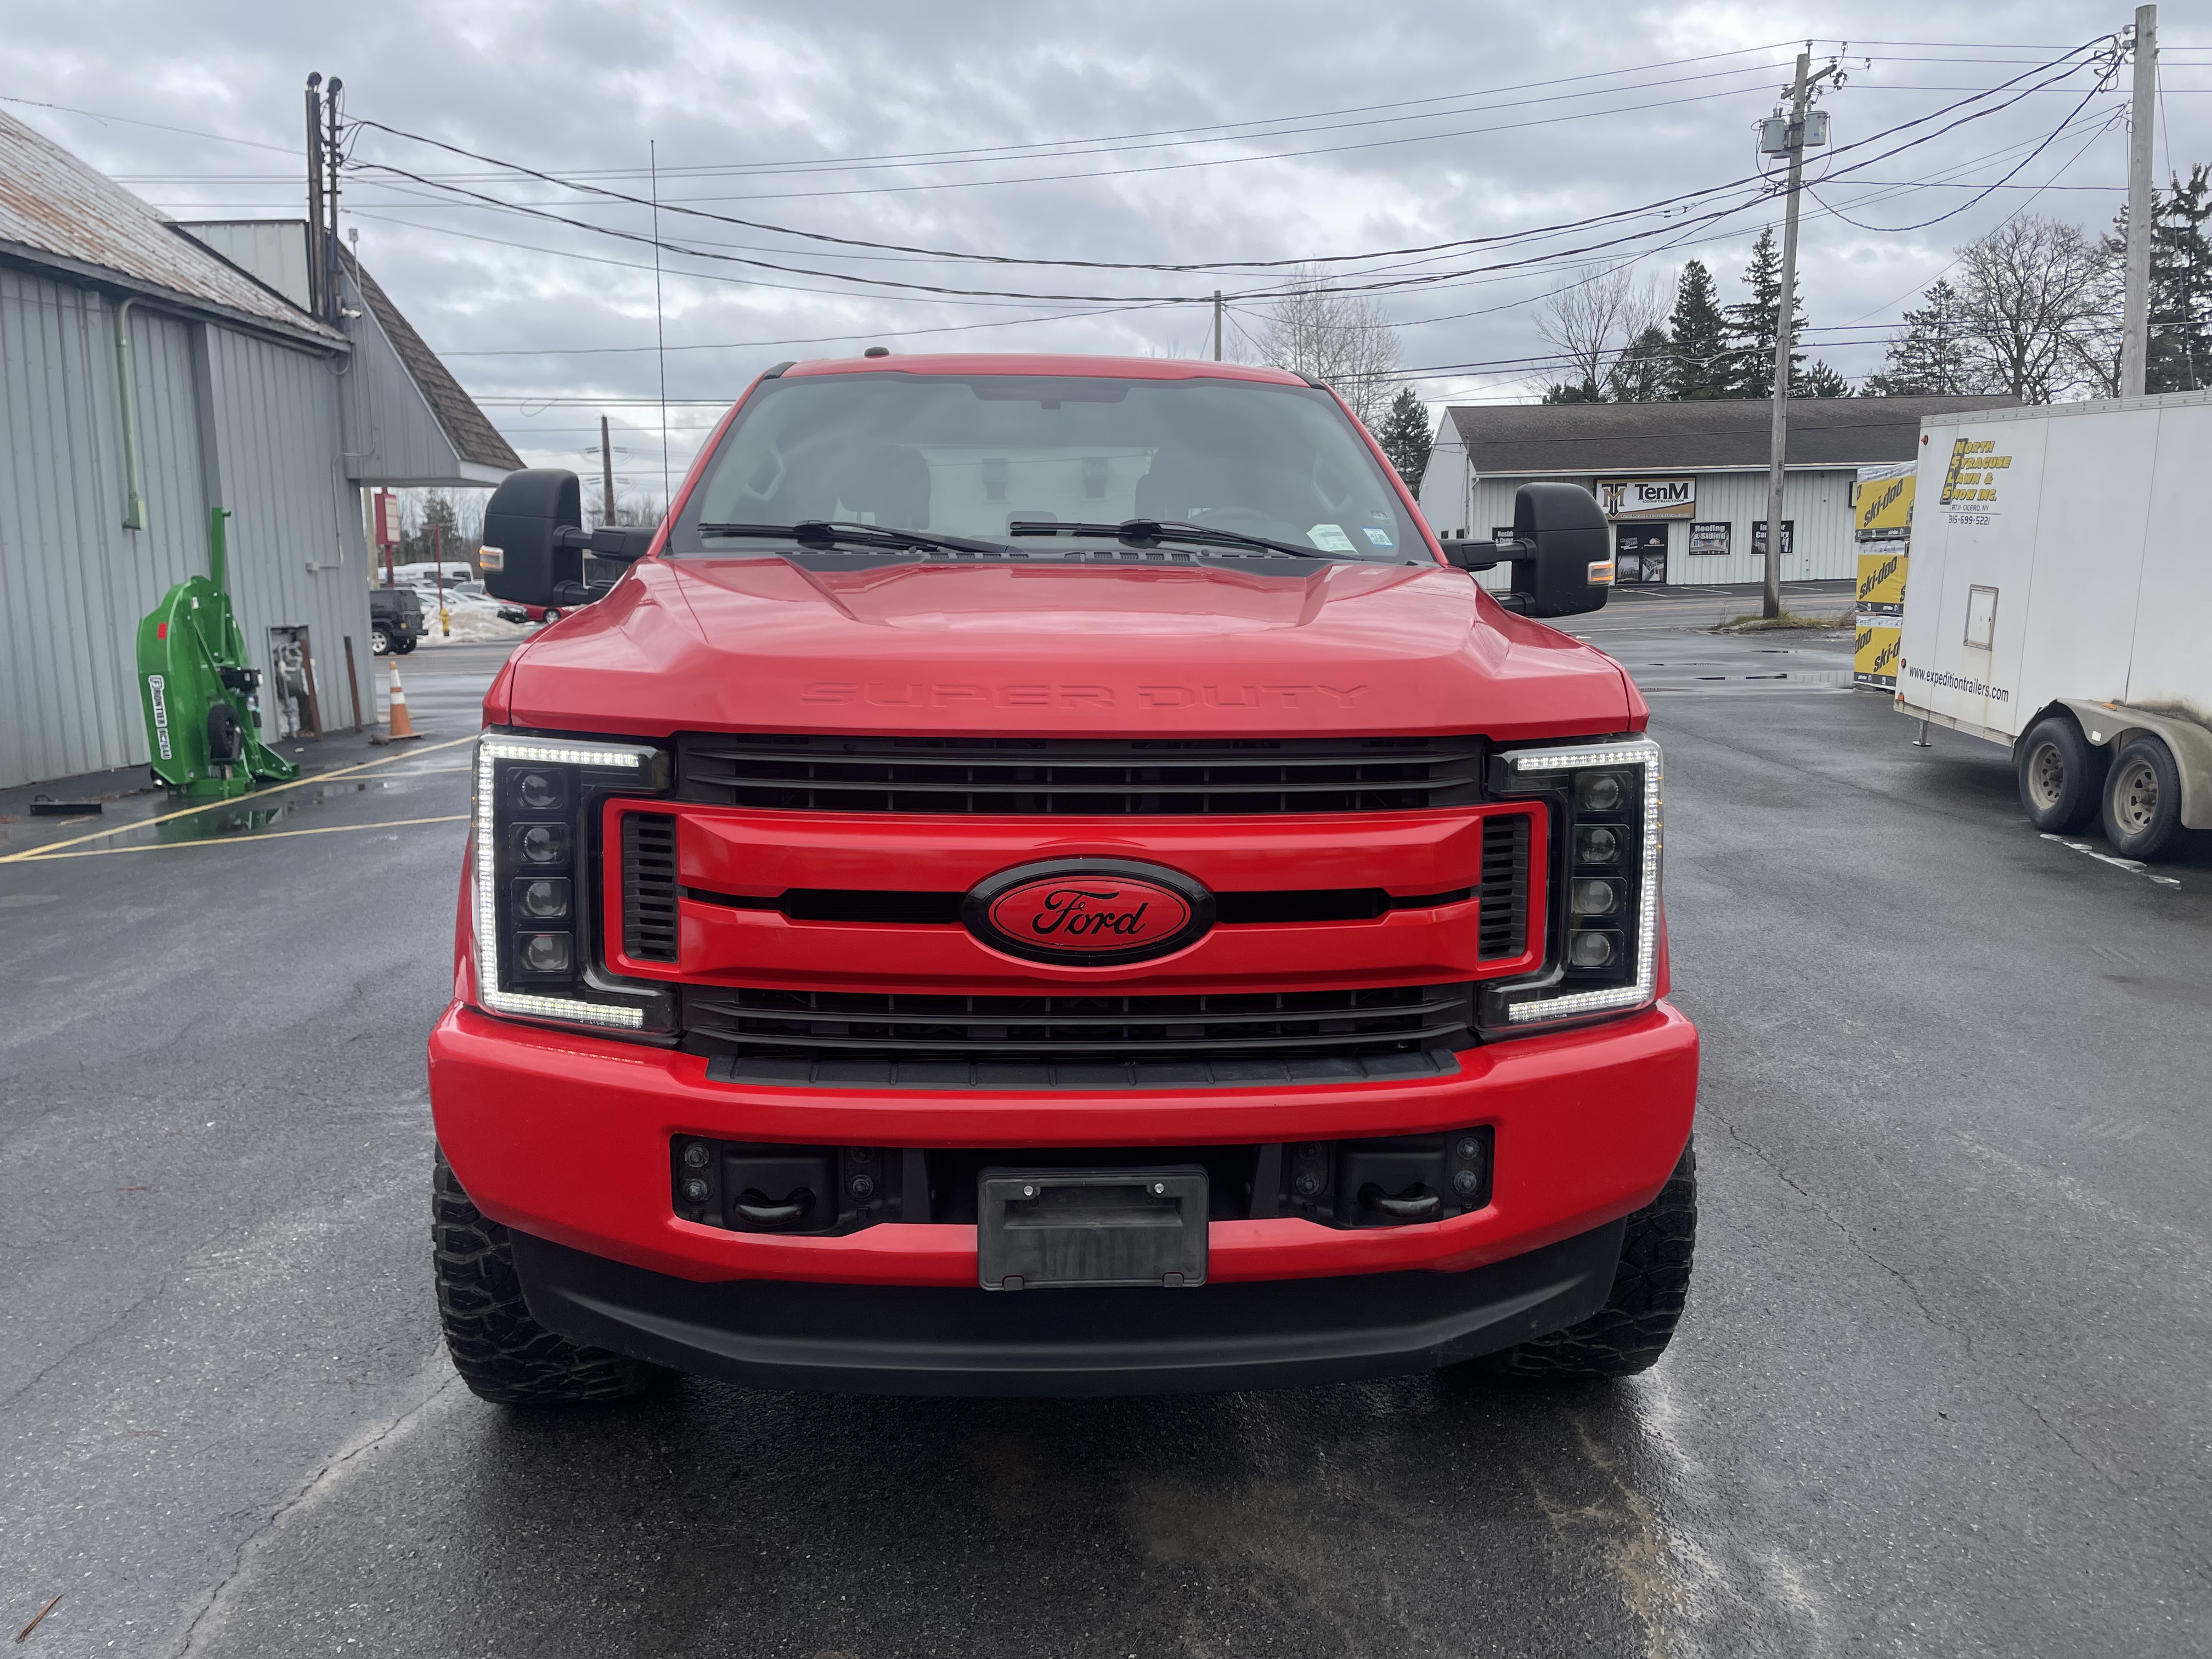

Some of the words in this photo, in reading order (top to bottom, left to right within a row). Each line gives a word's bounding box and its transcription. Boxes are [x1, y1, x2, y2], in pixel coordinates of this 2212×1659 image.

[1954, 441, 1995, 454] NORTH
[1950, 455, 2012, 469] SYRACUSE
[1946, 471, 1981, 484] LAWN
[1984, 472, 1993, 485] &
[1634, 483, 1689, 500] TenM
[1942, 486, 1977, 500] SNOW
[1909, 666, 2009, 702] www.expeditiontrailers.com
[800, 681, 1116, 710] SUPER
[1137, 684, 1369, 709] DUTY
[1032, 889, 1149, 935] Ford
